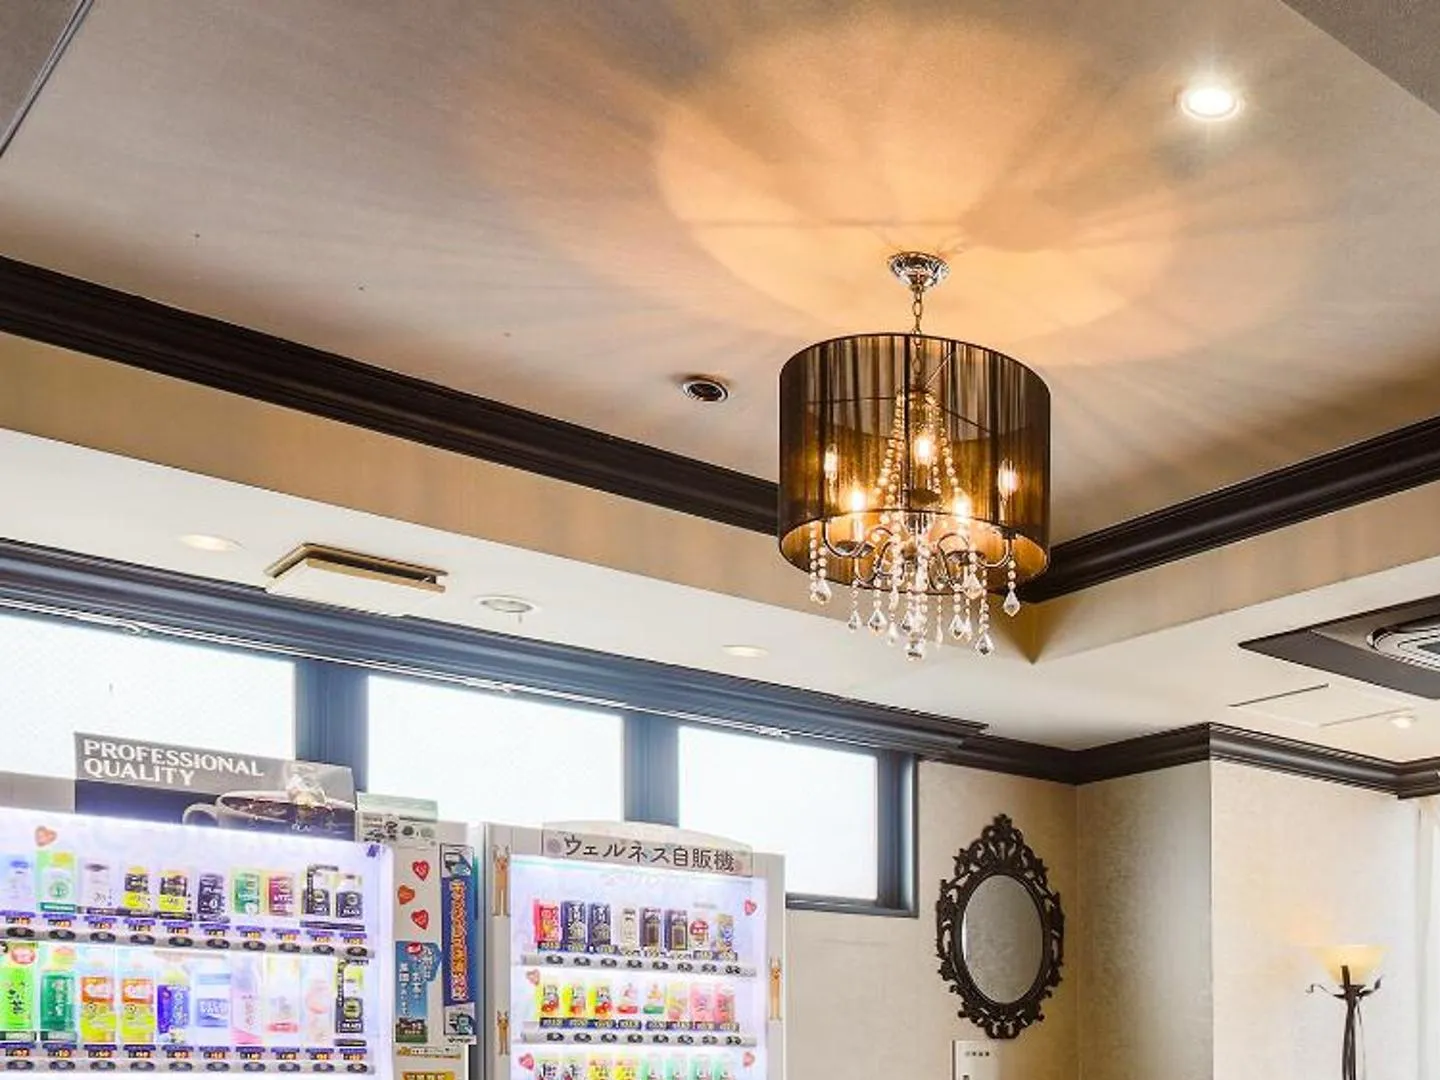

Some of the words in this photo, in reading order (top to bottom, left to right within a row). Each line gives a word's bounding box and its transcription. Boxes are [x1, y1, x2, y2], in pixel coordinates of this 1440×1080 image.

[83, 738, 264, 777] PROFESSIONAL
[83, 757, 195, 787] QUALITY
[563, 834, 736, 872] ウェルネス自販機
